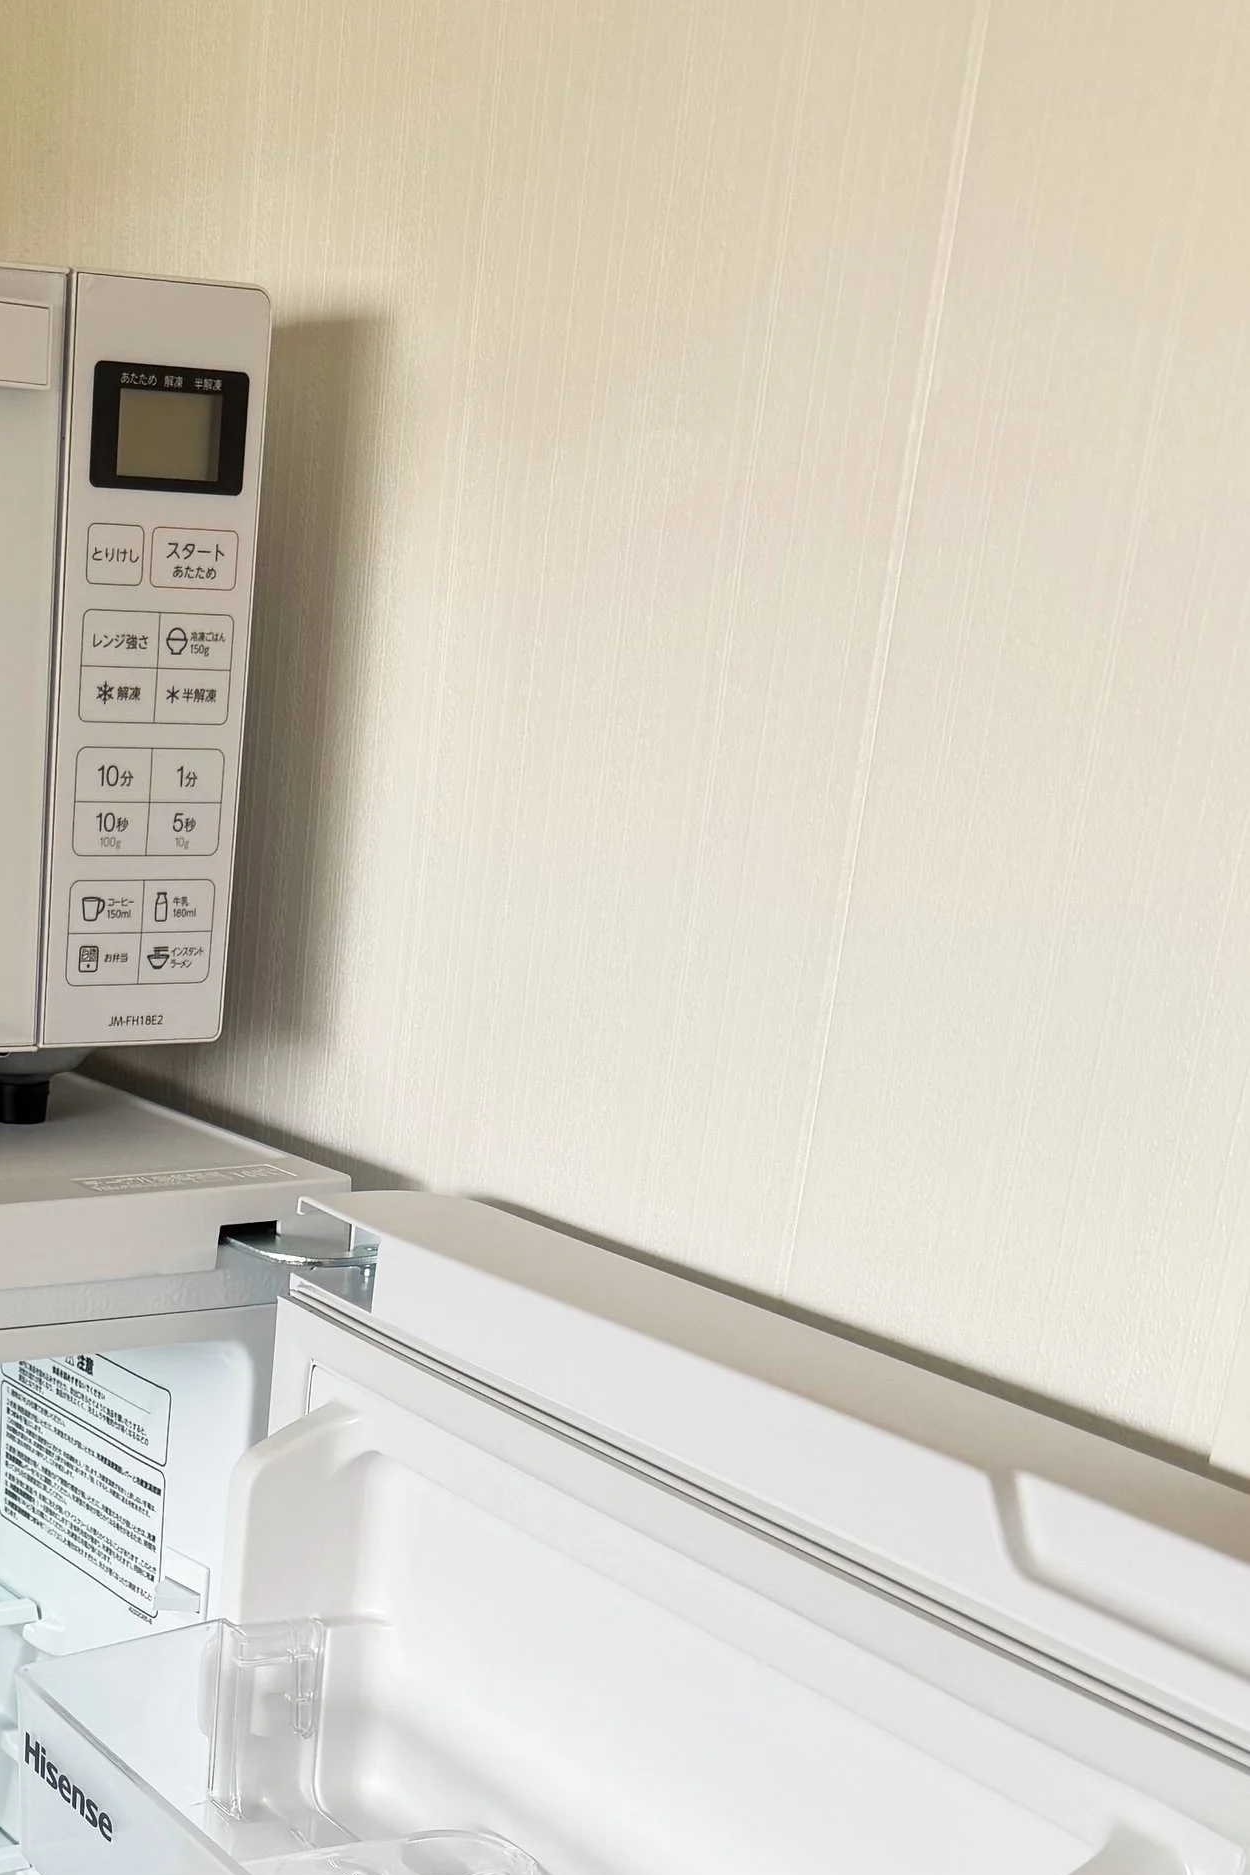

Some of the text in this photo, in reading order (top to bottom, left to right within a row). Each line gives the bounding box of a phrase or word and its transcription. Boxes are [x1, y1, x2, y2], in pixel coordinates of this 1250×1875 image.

[121, 371, 158, 387] あたため
[91, 546, 140, 564] とりけし
[166, 541, 227, 563] スタート
[172, 564, 217, 580] あたため
[92, 632, 150, 650] レンジ強さ
[189, 644, 210, 657] 150g
[117, 686, 142, 702] 解凍
[182, 687, 217, 703] 半解凍
[97, 764, 134, 787] 10分
[176, 765, 198, 788] 1分
[95, 812, 129, 833] 10秒
[172, 812, 197, 833] 5秒
[100, 836, 121, 850] 100g
[107, 897, 135, 908] コーヒー
[172, 896, 190, 906] 牛乳
[107, 909, 132, 919] 150ml
[104, 952, 129, 963] お弁当
[171, 946, 205, 957] インスタント
[169, 959, 193, 969] ラーメン
[107, 1015, 164, 1027] JM-FH18E2
[24, 1731, 114, 1843] Hisense
